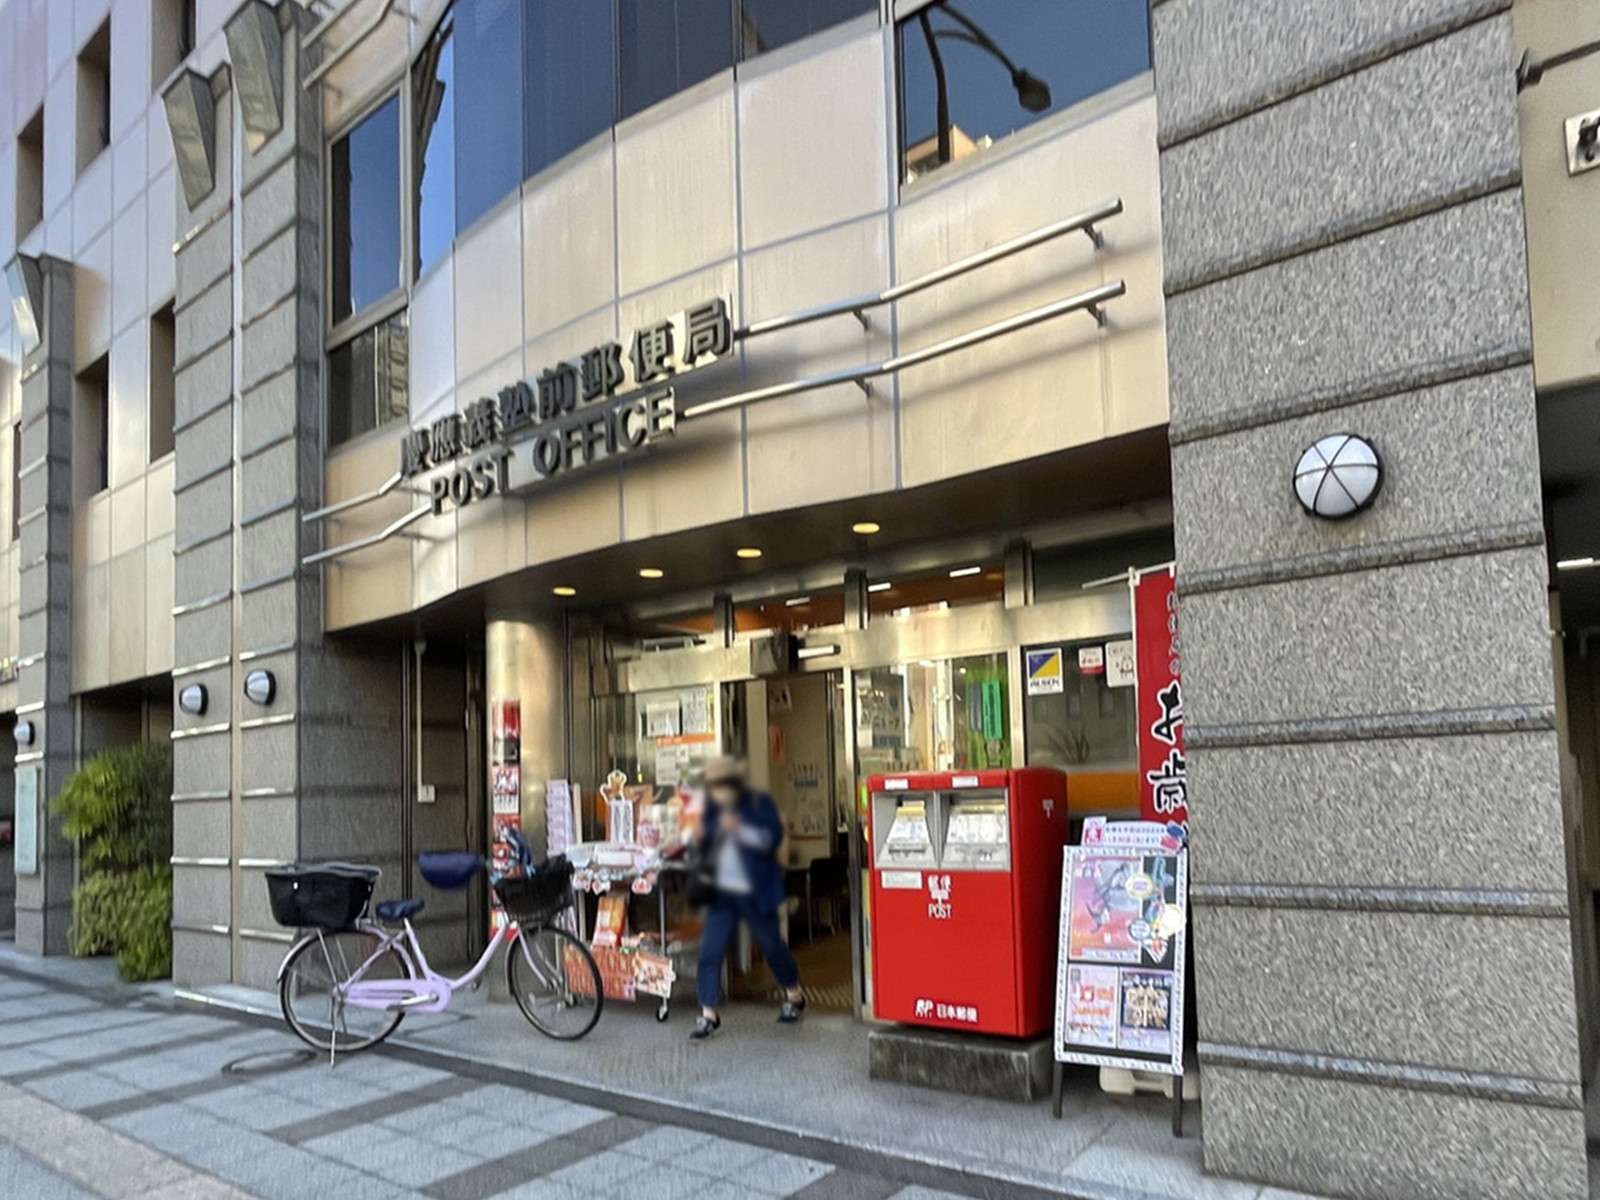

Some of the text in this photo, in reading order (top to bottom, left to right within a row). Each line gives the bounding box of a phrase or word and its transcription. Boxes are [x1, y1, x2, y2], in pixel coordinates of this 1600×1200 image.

[430, 388, 676, 515] POST OFFICE
[928, 903, 951, 919] POST
